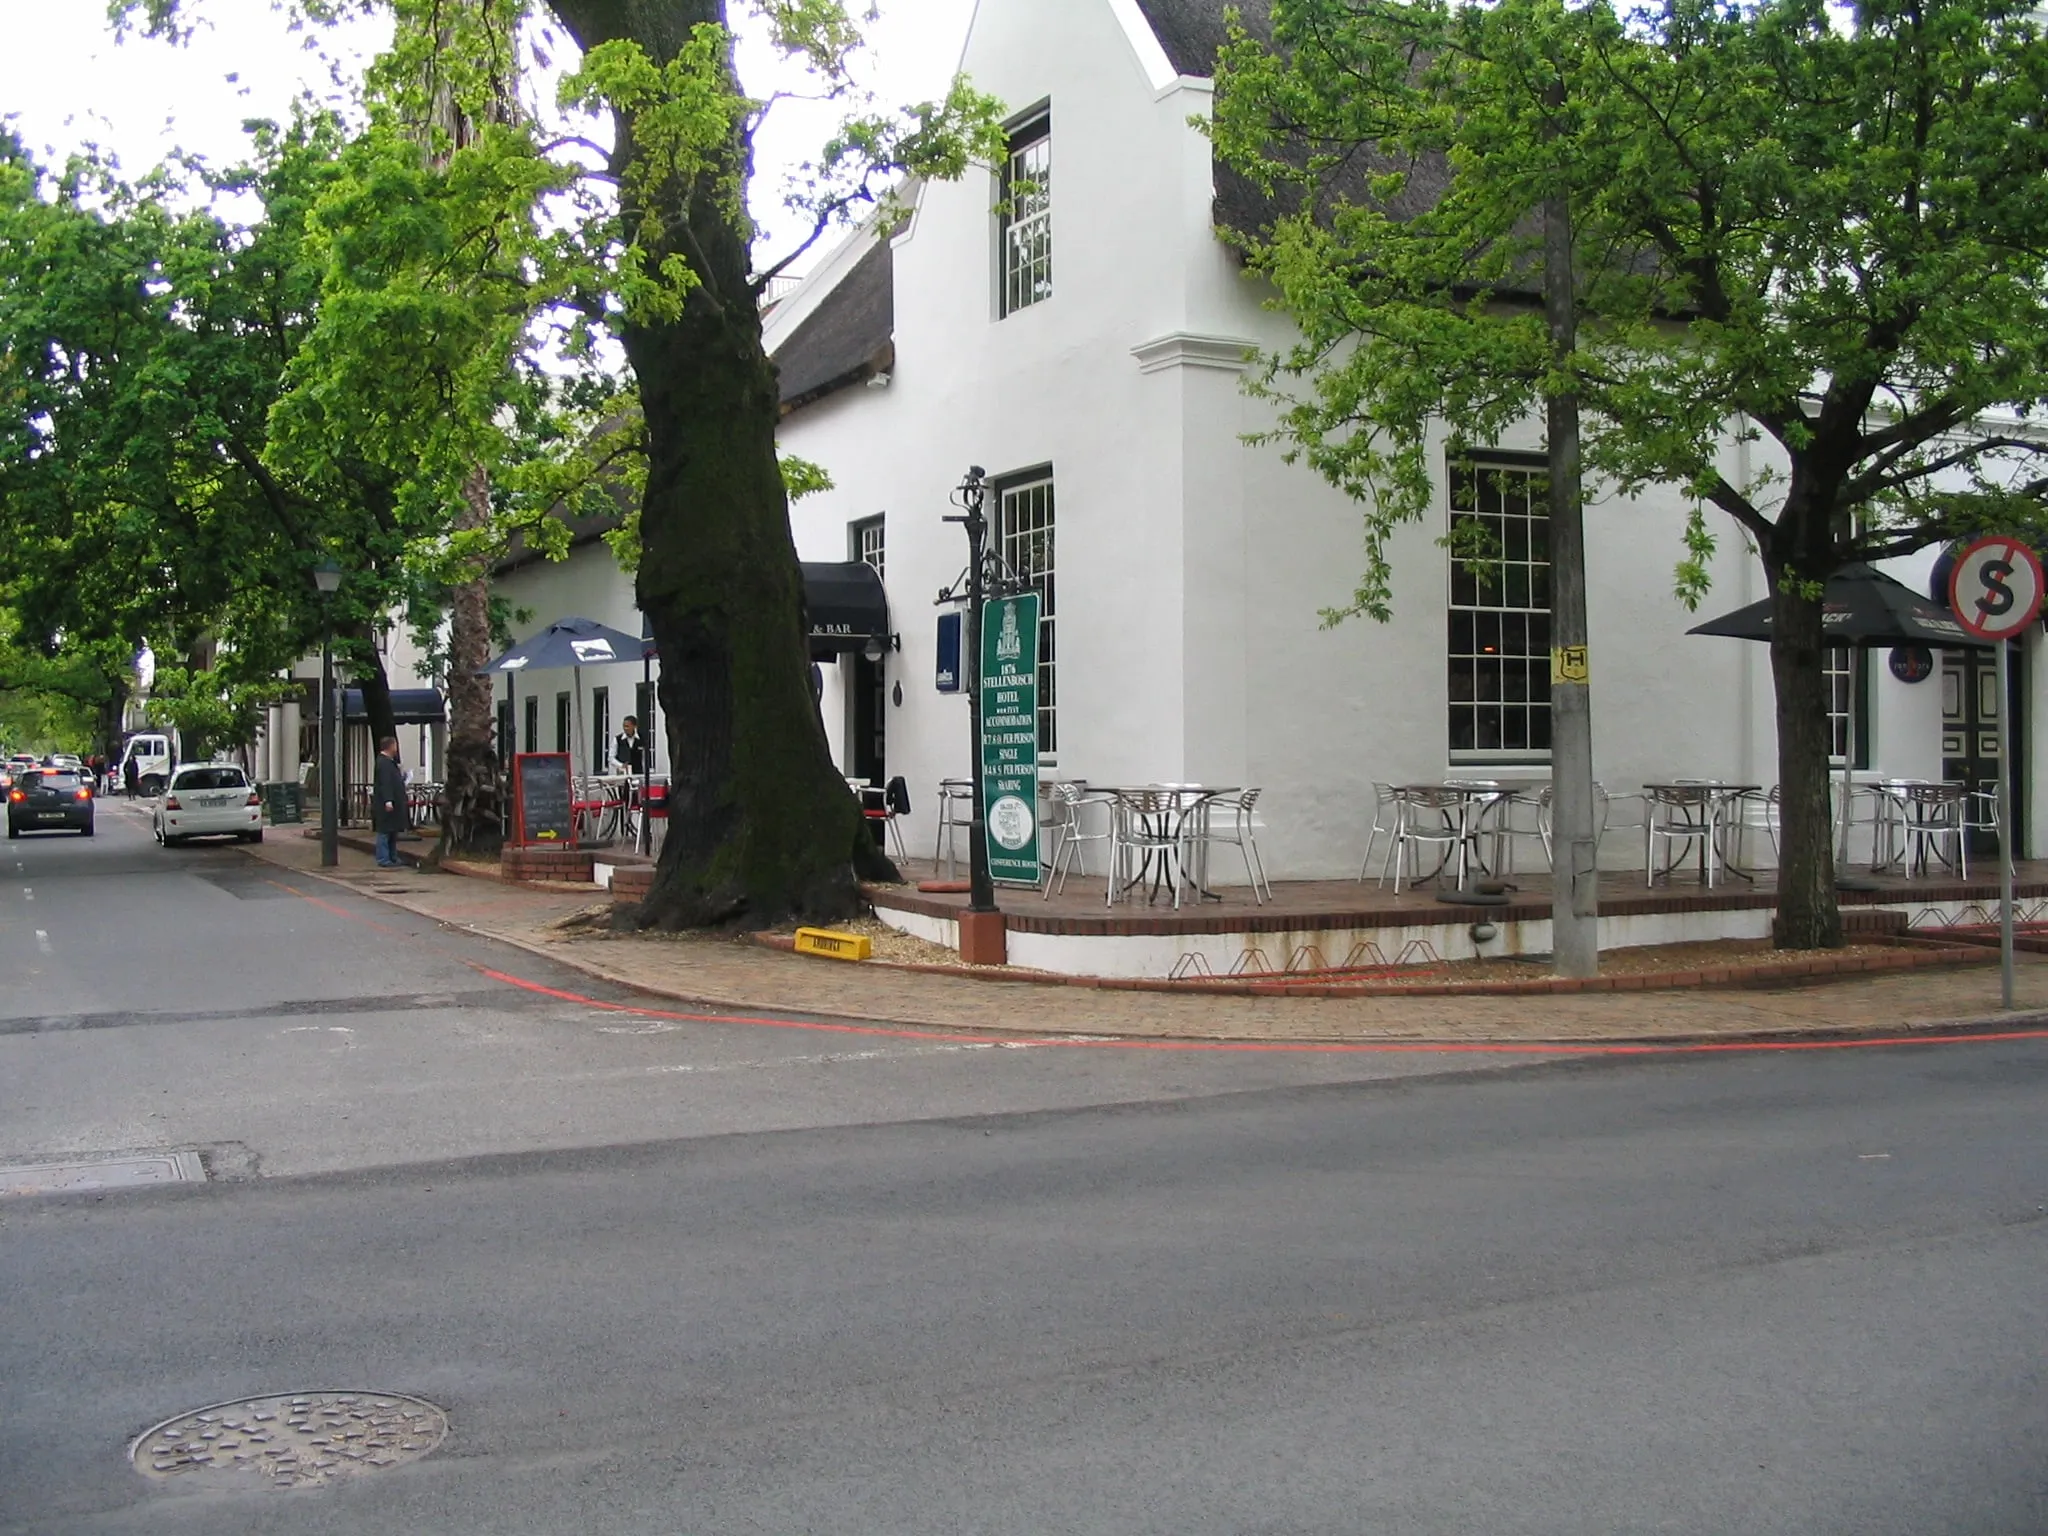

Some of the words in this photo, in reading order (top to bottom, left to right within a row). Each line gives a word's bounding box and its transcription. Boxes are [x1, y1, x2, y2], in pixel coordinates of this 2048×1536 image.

[1974, 559, 2015, 616] S
[826, 624, 852, 634] BAR
[1566, 652, 1584, 666] H
[983, 674, 1033, 688] STELLENBOSCH
[997, 691, 1019, 702] HOTEL
[985, 714, 1032, 727] ACCOMMODATION
[1003, 732, 1014, 744] PER
[1014, 732, 1035, 744] PERSON
[999, 748, 1018, 760] SINGLE
[1003, 764, 1014, 775] PER
[1014, 763, 1035, 775] PERSON
[991, 858, 1020, 867] CONFERENCE
